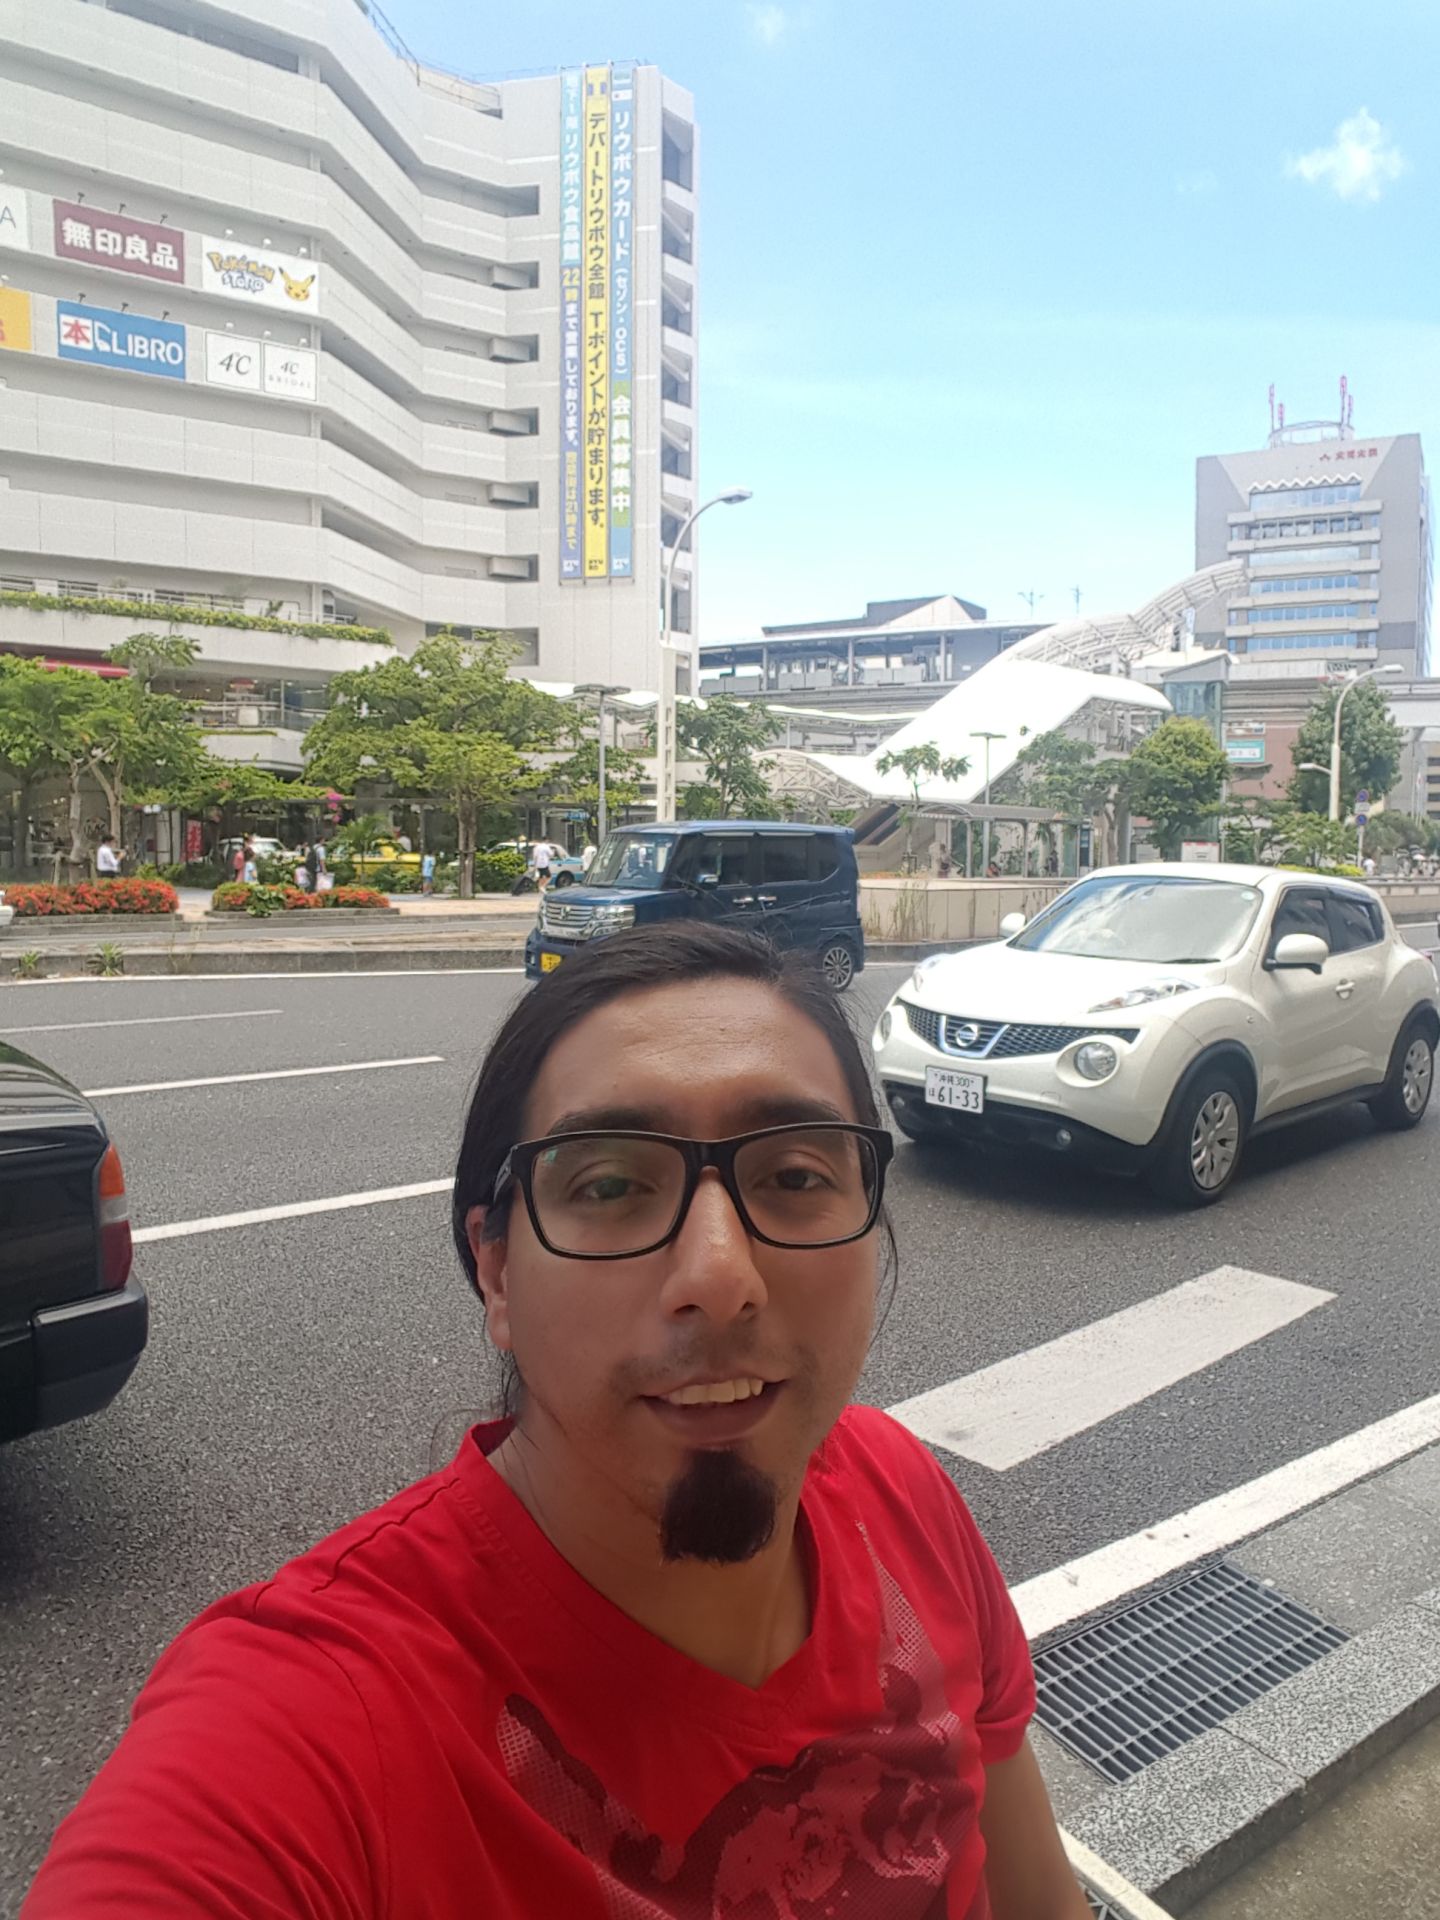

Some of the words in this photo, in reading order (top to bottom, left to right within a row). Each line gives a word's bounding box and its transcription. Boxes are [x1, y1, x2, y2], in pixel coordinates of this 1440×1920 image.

[61, 217, 179, 272] 無印良品
[62, 319, 91, 345] 本
[111, 328, 184, 366] LIBRO
[219, 352, 251, 375] 4C
[938, 1086, 980, 1109] 61-33
